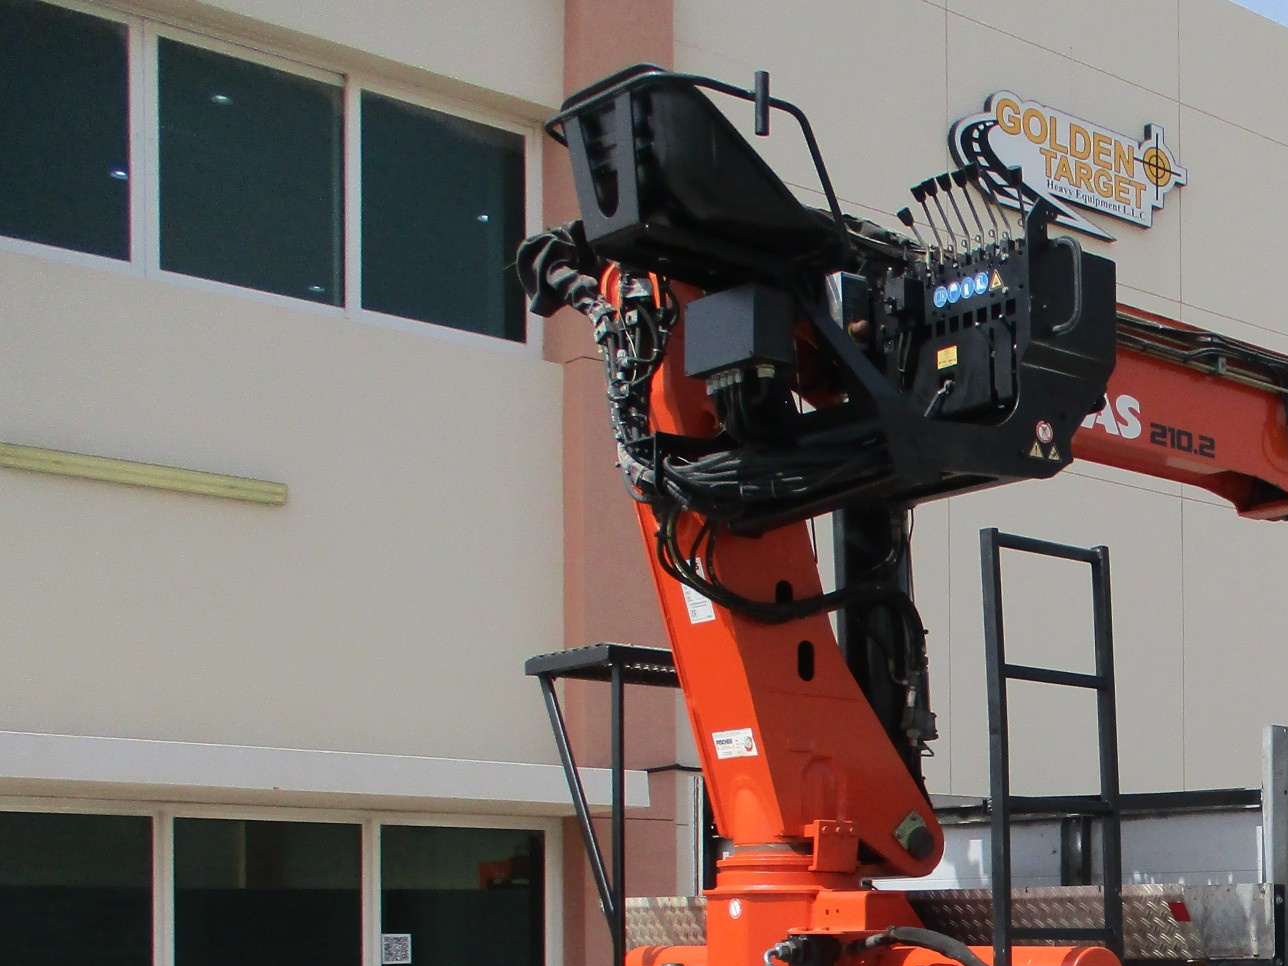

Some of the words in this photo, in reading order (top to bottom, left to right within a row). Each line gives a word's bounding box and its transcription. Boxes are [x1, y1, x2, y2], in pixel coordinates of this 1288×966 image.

[996, 98, 1135, 178] GOLDEN
[1040, 147, 1147, 209] TARGET
[1047, 179, 1073, 198] Heavy
[1076, 188, 1121, 212] Equipment
[1150, 423, 1215, 458] 210.2
